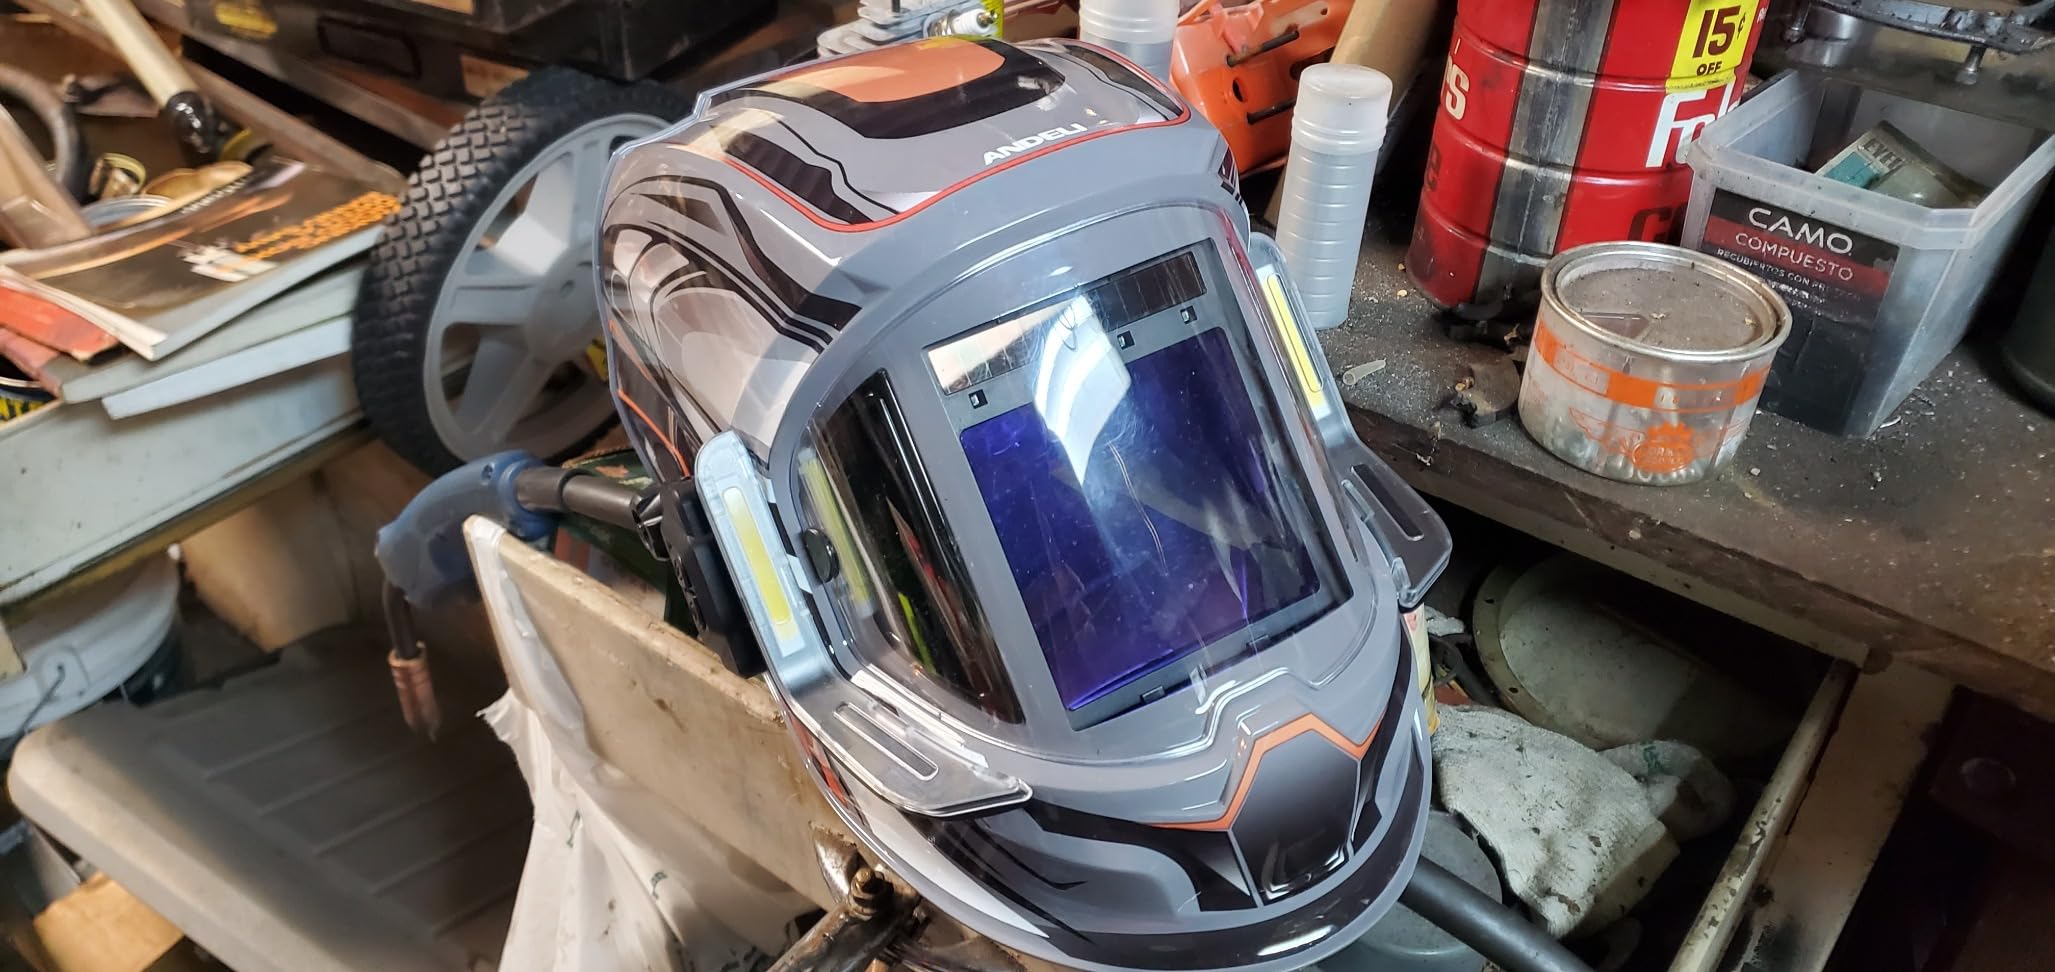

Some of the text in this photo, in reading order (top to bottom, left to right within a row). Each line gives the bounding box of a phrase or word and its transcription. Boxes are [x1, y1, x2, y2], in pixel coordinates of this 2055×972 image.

[1696, 61, 1722, 76] OFF
[983, 123, 1088, 165] ANDELI
[1735, 232, 1854, 281] COMPUESTO
[1787, 272, 1810, 286] CON
